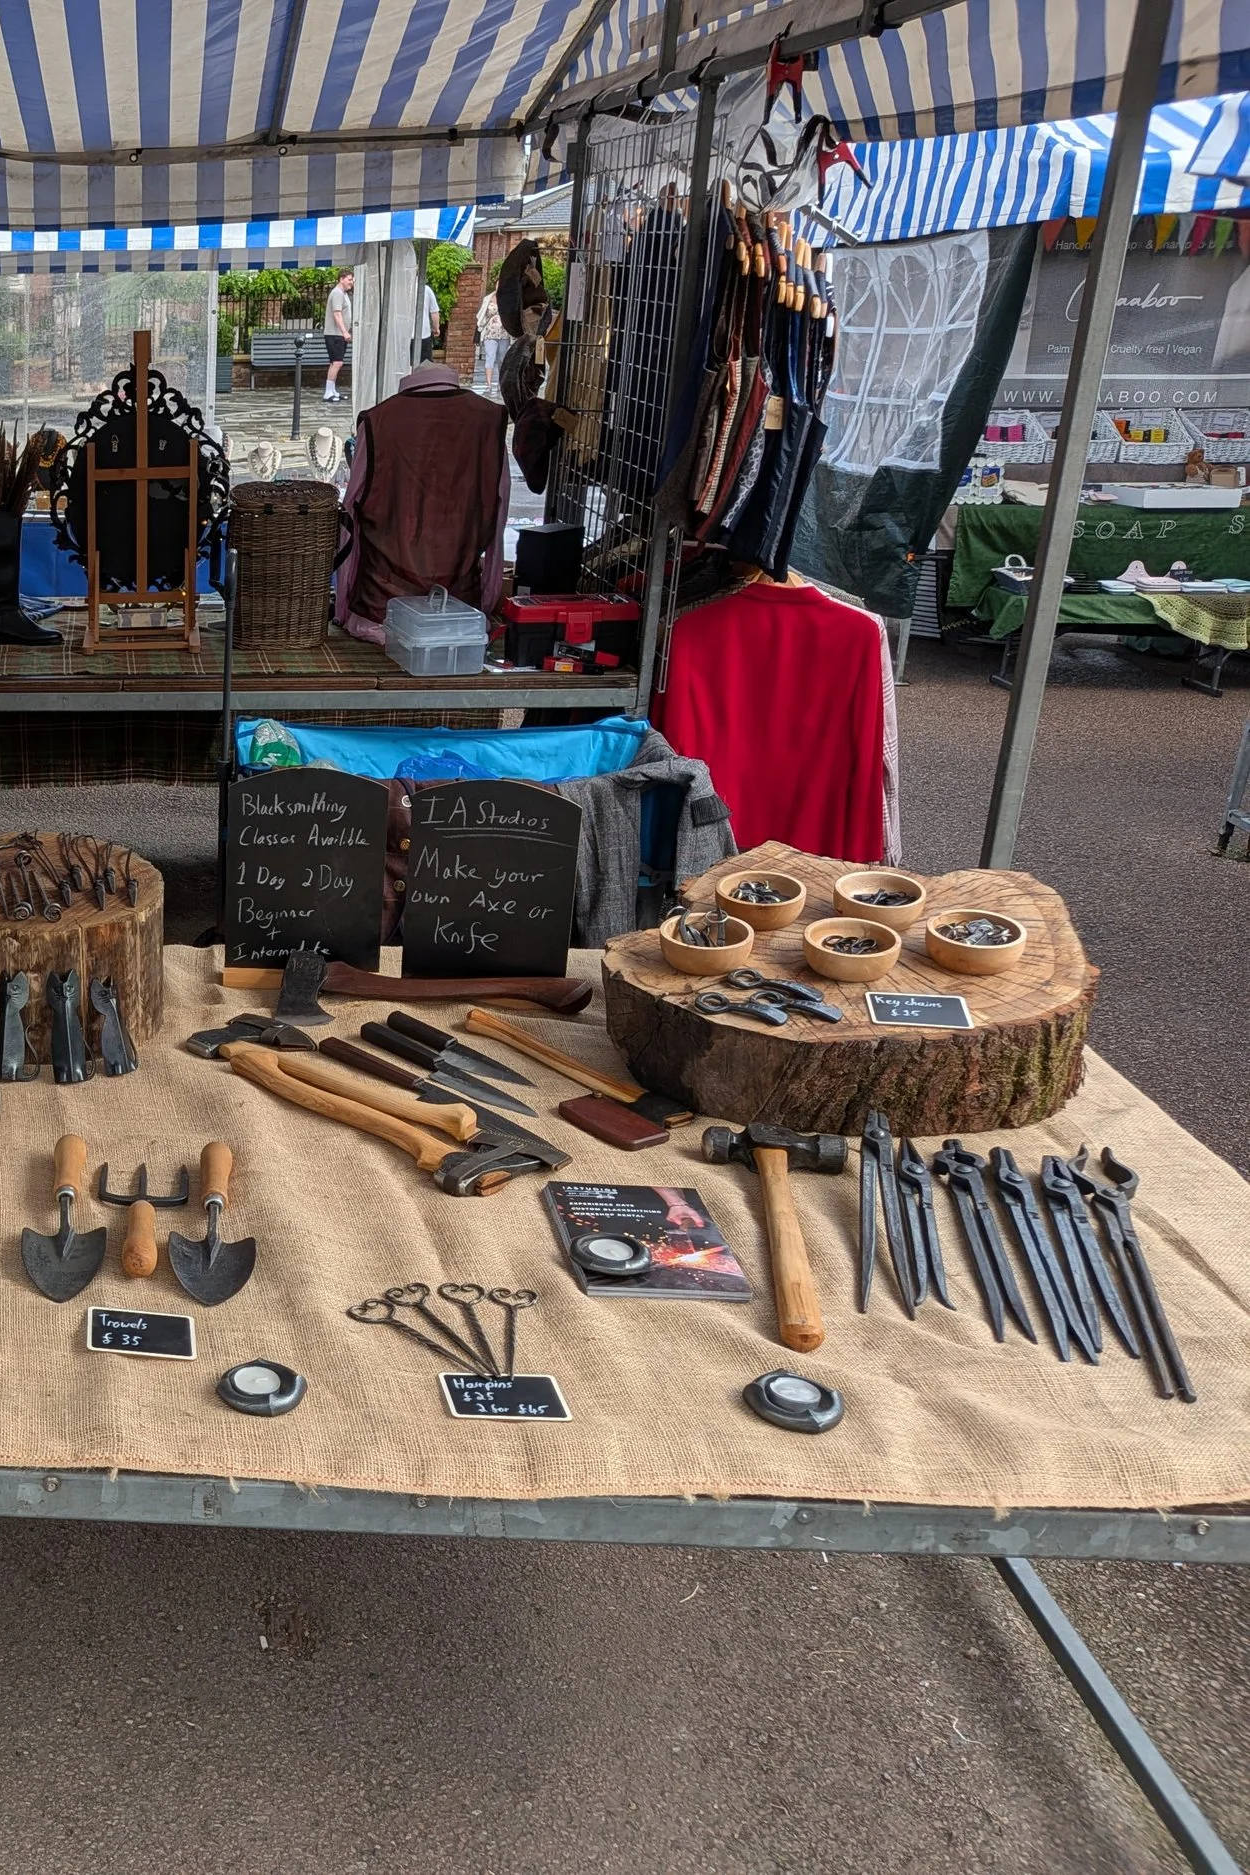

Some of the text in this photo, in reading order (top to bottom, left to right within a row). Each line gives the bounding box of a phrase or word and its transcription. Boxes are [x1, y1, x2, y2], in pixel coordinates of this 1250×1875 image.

[1047, 344, 1070, 354] Palm
[1110, 344, 1143, 357] Cruelty
[1145, 344, 1165, 354] free
[1172, 344, 1202, 356] Vegan
[1072, 520, 1177, 540] SOAP
[241, 793, 348, 823] Blacksmithing
[476, 800, 550, 830] Studios
[236, 861, 246, 885] 1
[256, 866, 286, 890] Day
[414, 845, 545, 889] Make your
[237, 896, 315, 930] Beginner
[411, 890, 555, 920] own Axe or
[434, 916, 499, 954] Knife
[874, 995, 901, 1007] Key
[99, 1313, 148, 1330] Trowels
[463, 1391, 495, 1402] £25
[476, 1403, 488, 1413] 2
